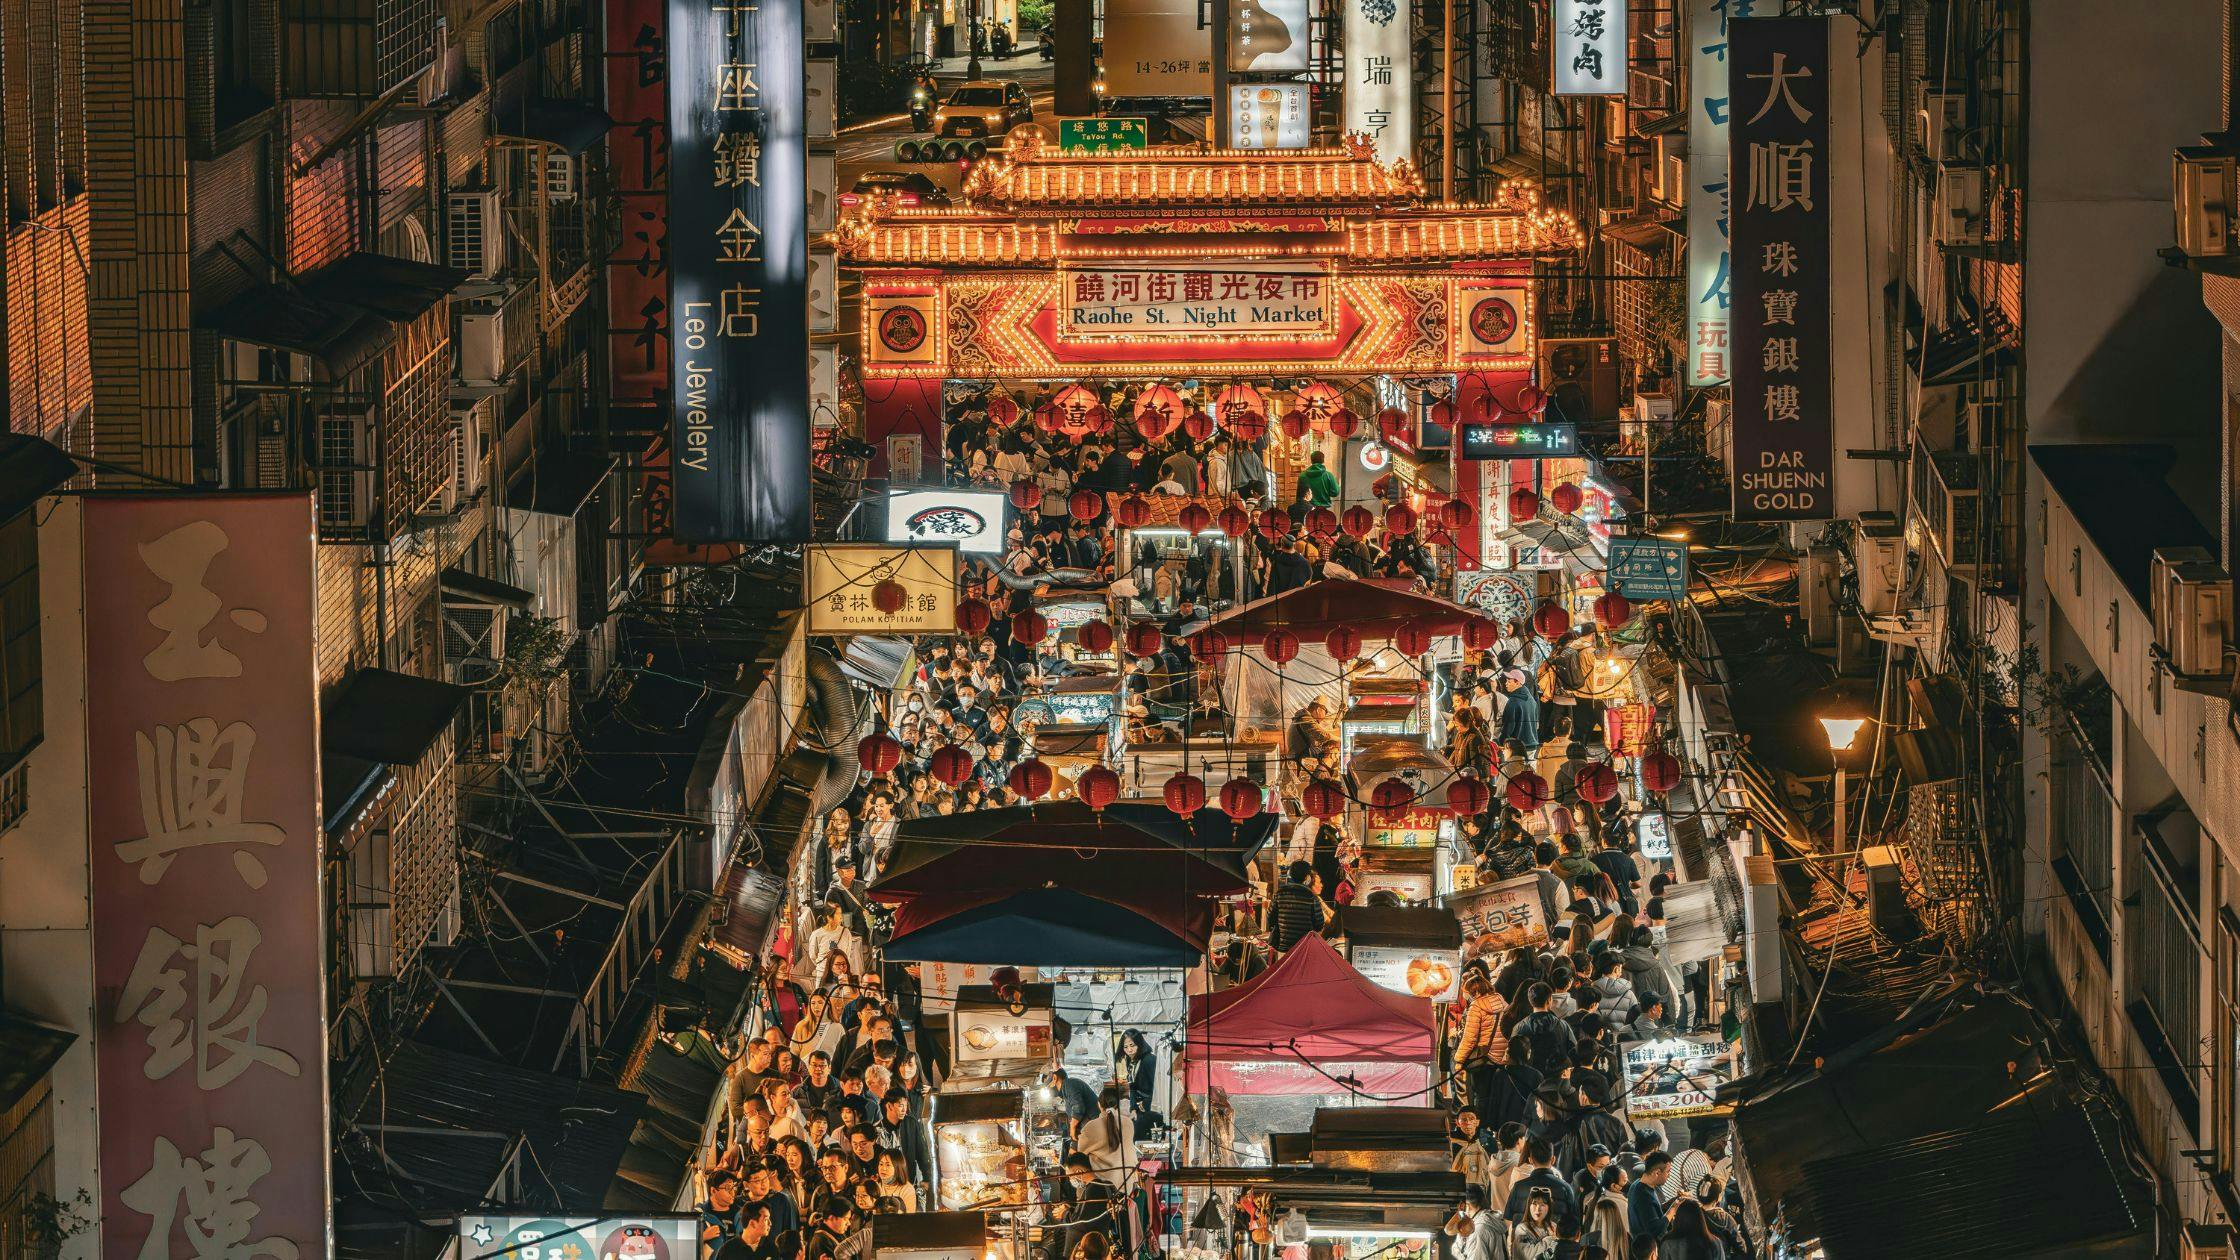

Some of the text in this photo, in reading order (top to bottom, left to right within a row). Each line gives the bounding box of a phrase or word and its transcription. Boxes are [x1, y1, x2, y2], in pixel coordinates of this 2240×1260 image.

[1572, 0, 1606, 80] 烤肉
[1073, 121, 1132, 132] 塔悠路
[1746, 53, 1814, 213] 大順
[1074, 273, 1319, 302] 饒河街觀光夜市
[1073, 305, 1324, 328] Raohe St. Night Market
[1761, 241, 1800, 421] 珠寶銀樓
[1696, 322, 1728, 380] 玩具
[680, 302, 714, 471] Leo Jewelery
[1761, 451, 1805, 468] DAR
[1742, 472, 1825, 490] SHUENN
[1754, 493, 1814, 511] GOLD
[828, 593, 937, 612] 寶林館
